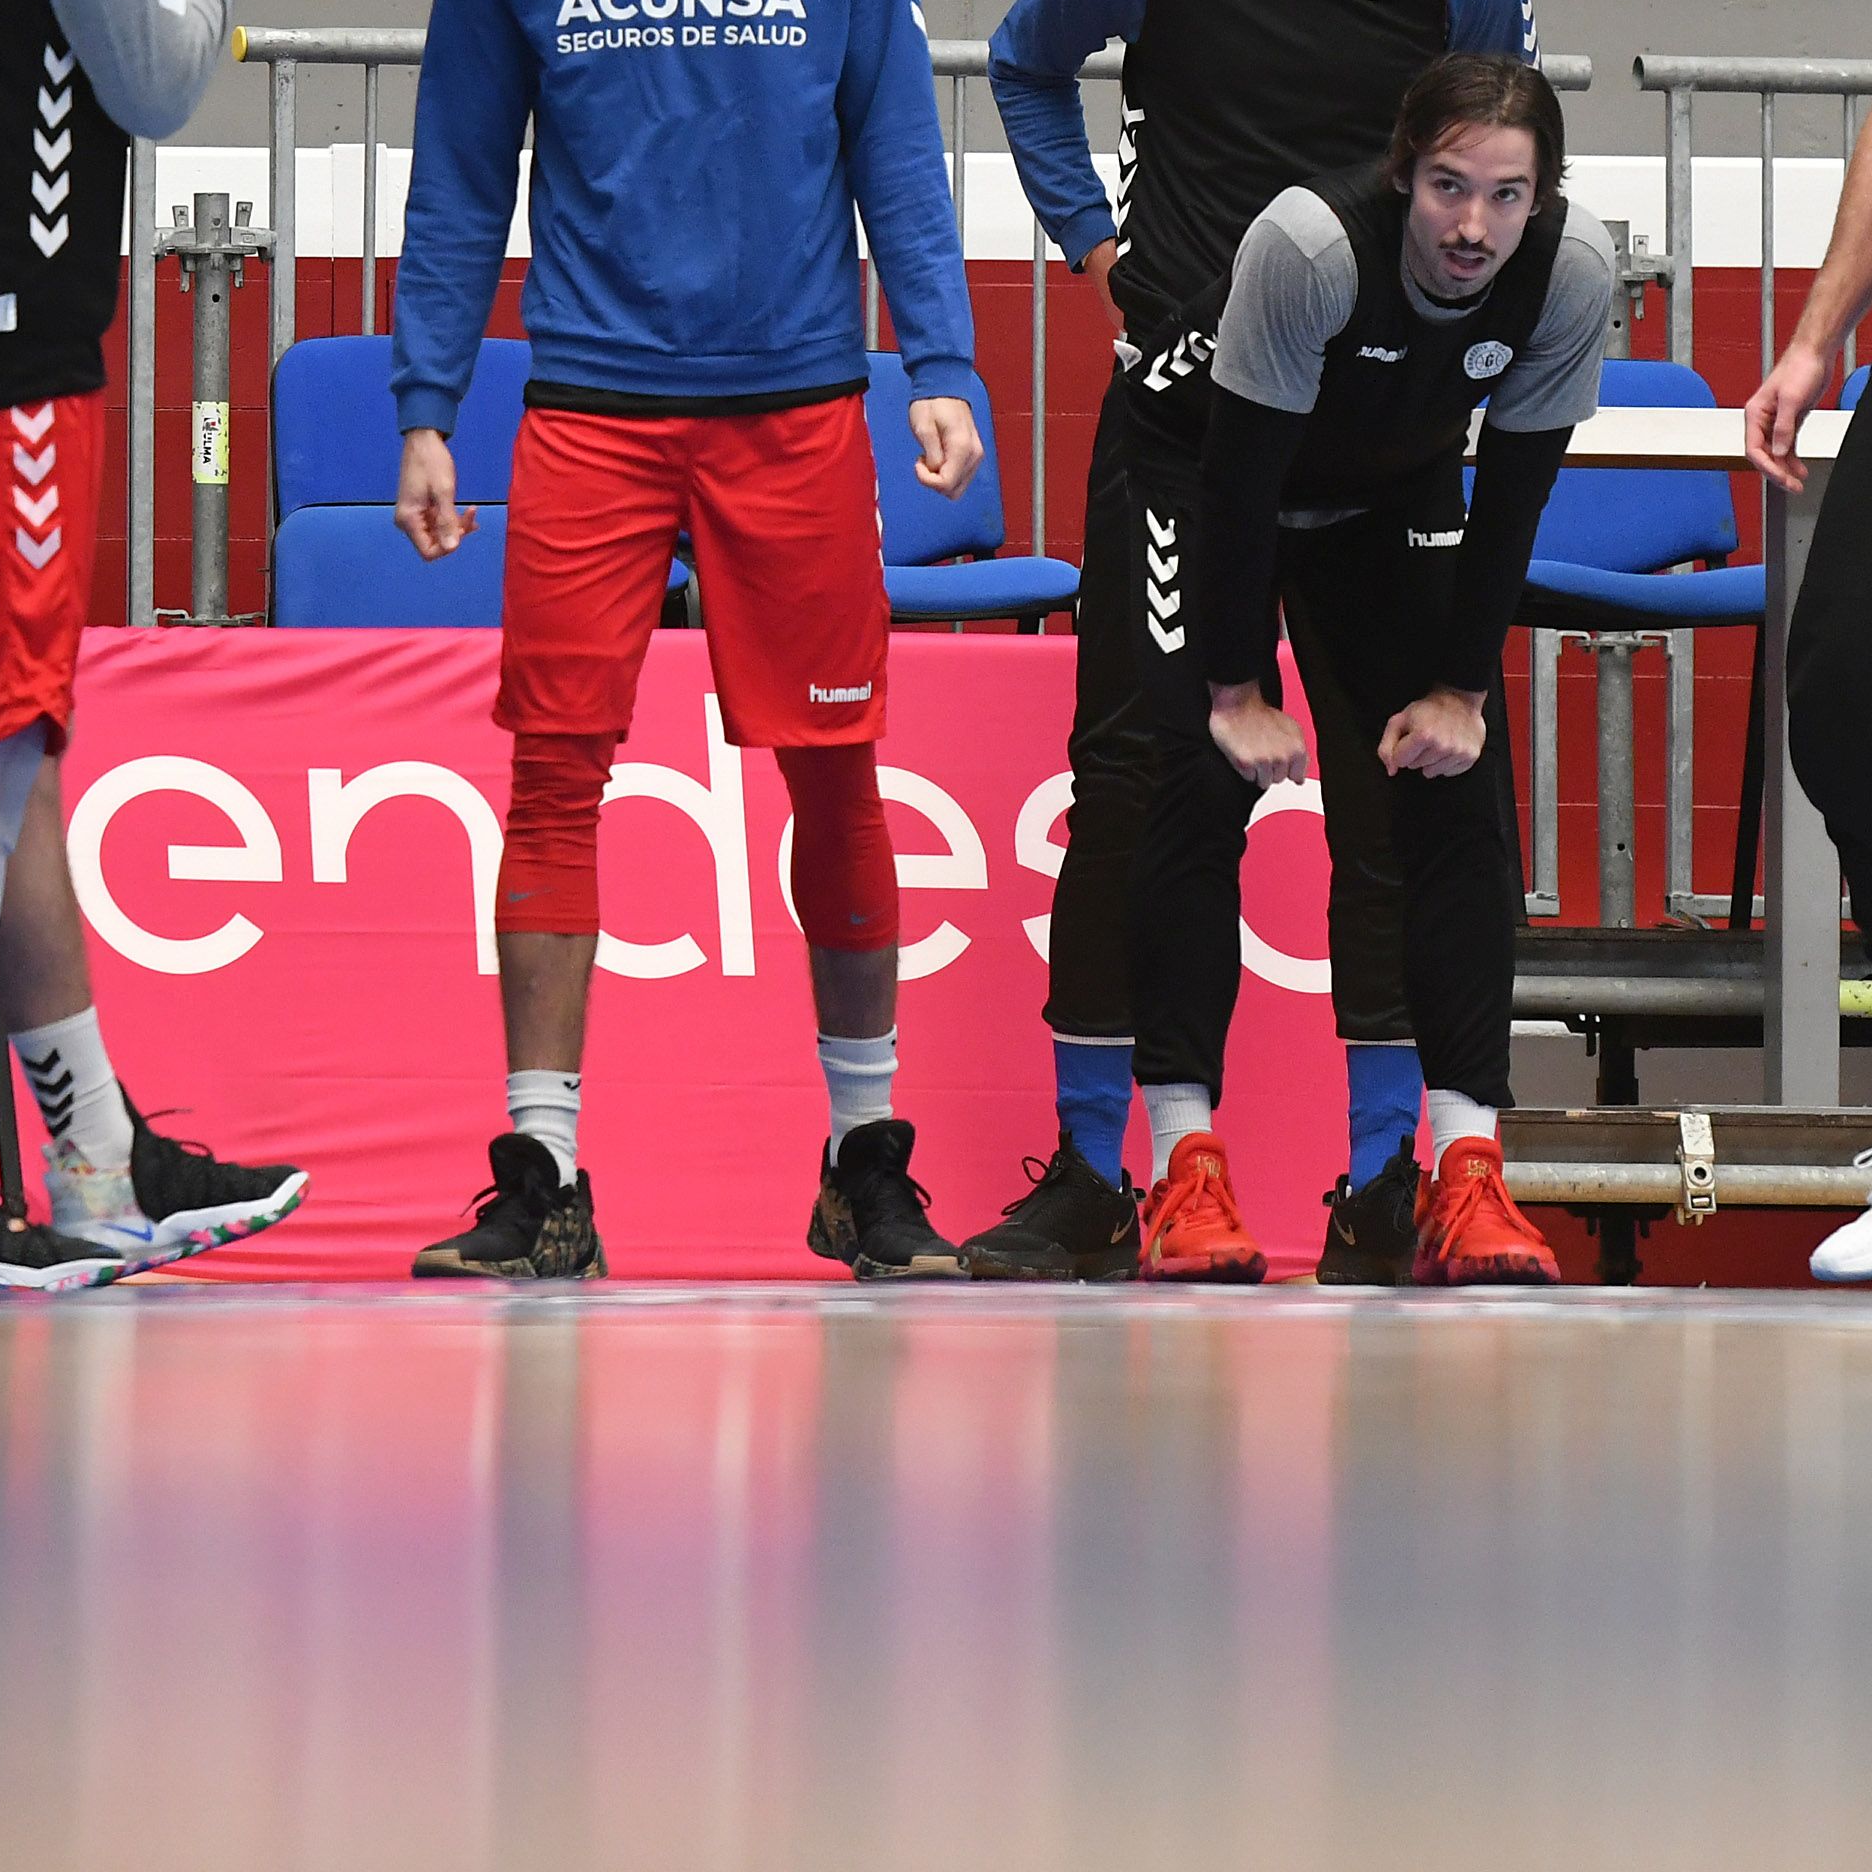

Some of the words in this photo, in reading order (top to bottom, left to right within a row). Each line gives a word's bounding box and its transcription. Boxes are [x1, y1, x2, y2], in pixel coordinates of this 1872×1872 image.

[556, 26, 676, 55] SEGUROS
[681, 24, 717, 47] DE
[723, 24, 808, 47] SALUD
[808, 679, 872, 704] hummel
